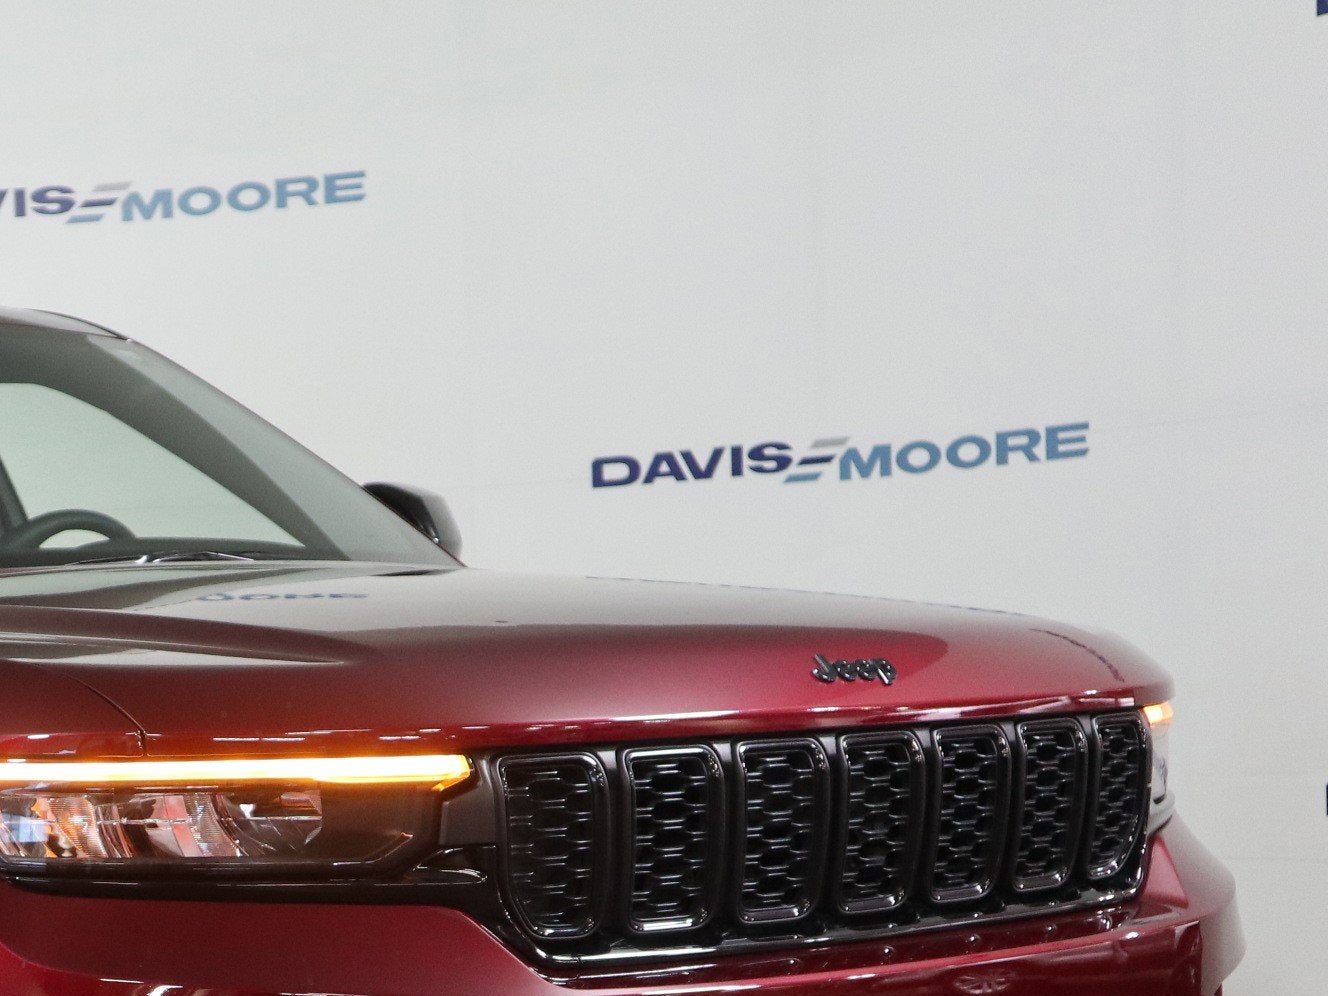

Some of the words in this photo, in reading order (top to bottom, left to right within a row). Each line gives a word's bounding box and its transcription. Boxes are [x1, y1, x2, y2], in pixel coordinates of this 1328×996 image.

[120, 170, 367, 222] MOORE
[589, 440, 793, 488] DAVIS
[837, 421, 1090, 481] MOORE
[812, 652, 897, 685] Jeep
